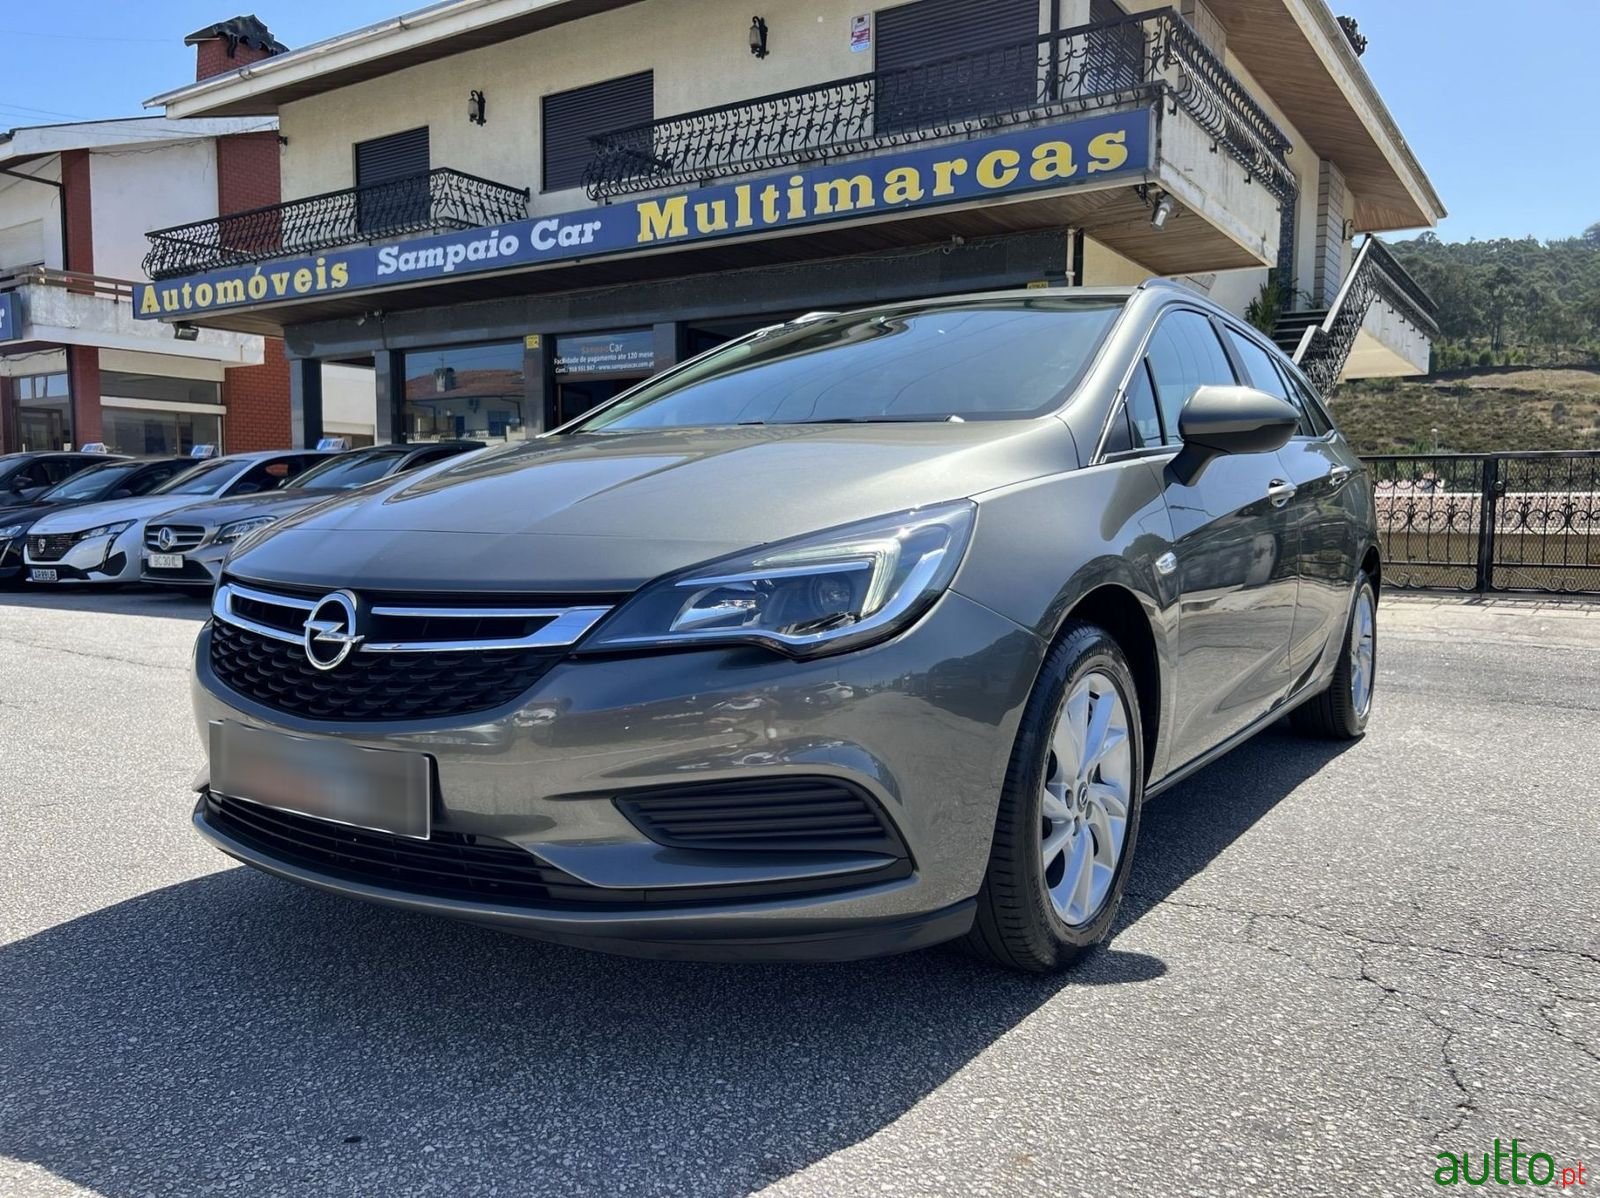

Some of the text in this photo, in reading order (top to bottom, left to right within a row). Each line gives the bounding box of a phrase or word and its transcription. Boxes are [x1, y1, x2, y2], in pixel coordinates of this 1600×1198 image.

[140, 129, 1129, 314] Automóveis Sampaio Car Multimarcas
